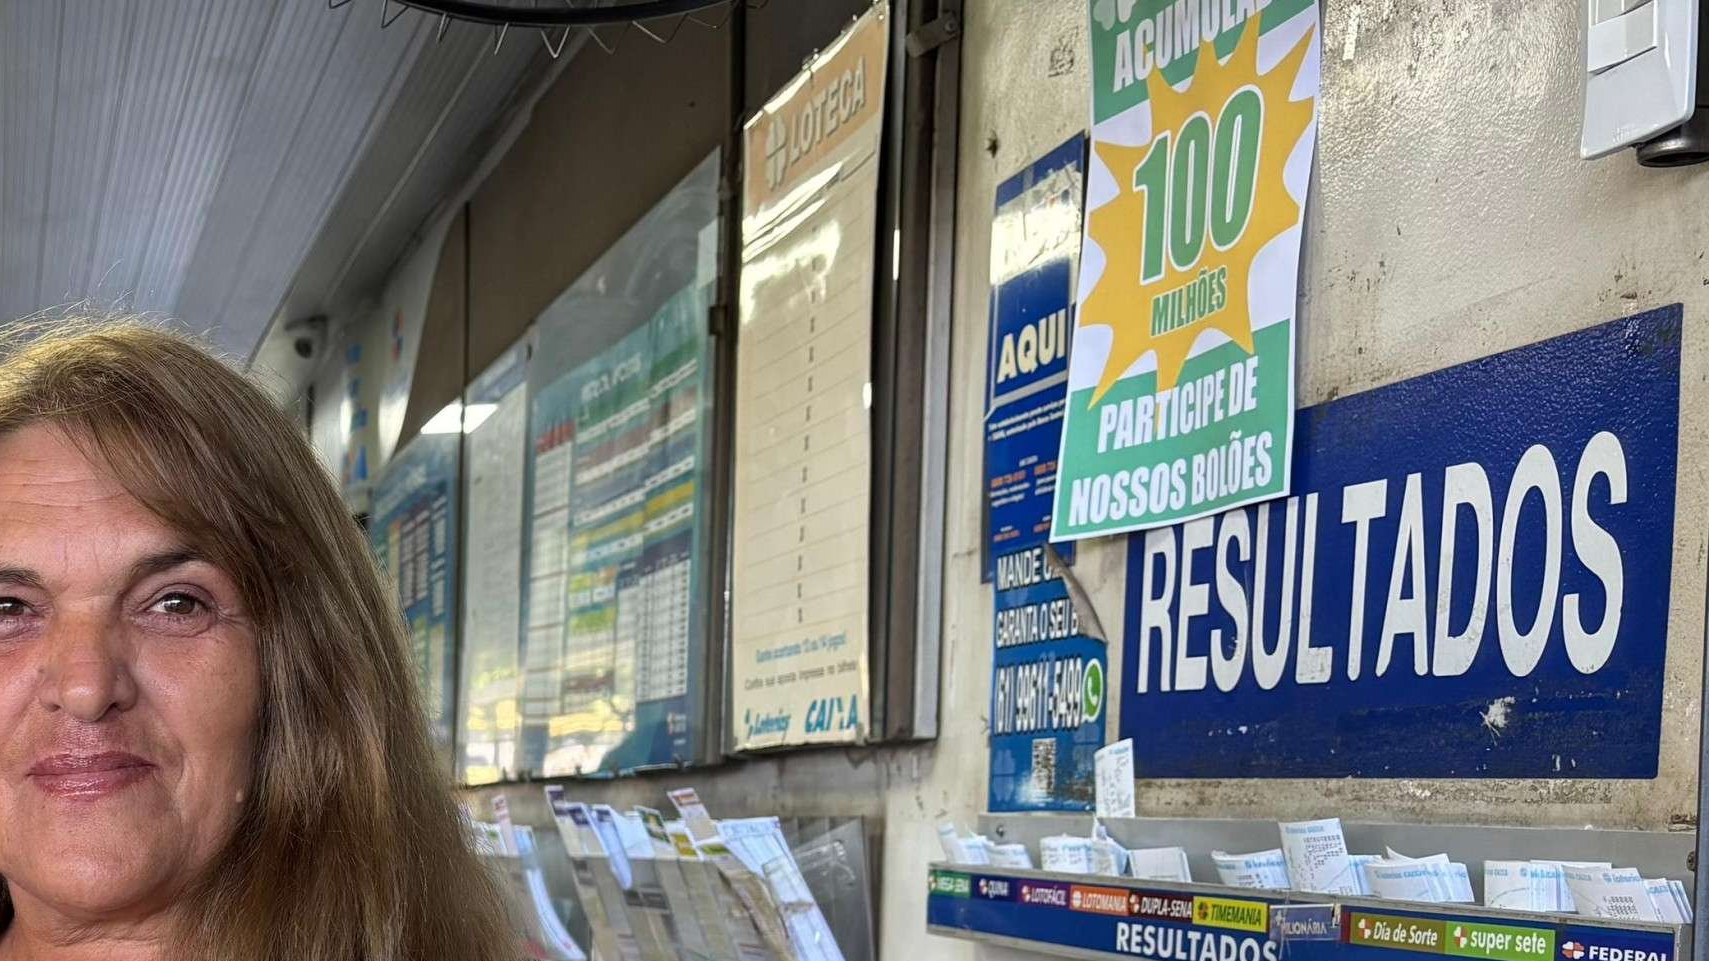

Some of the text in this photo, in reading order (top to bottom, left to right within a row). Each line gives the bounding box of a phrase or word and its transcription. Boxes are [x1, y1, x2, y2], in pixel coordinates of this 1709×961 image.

[1113, 0, 1272, 93] ACUMUL
[791, 57, 865, 167] LOTECA
[1133, 84, 1264, 286] 100
[1151, 265, 1227, 337] MILHÕES
[996, 308, 1066, 384] AQUI
[1097, 368, 1225, 453] PARTICIPE
[1228, 355, 1258, 416] DE
[1068, 430, 1273, 527] NOSSOS BOLÕES
[997, 548, 1041, 591] MANDE
[1137, 431, 1629, 694] RESULTADOS
[996, 603, 1038, 648] GARANTA
[1041, 603, 1047, 641] O
[1049, 598, 1070, 640] SEU
[1016, 657, 1082, 732] 99611-5499
[1082, 891, 1128, 912] LOTOMANIA
[1141, 896, 1193, 918] DUPLA-SENA
[1211, 904, 1262, 926] TIMEMANIA
[1373, 921, 1438, 946] Dia de Sorte
[1470, 930, 1547, 955] super sete
